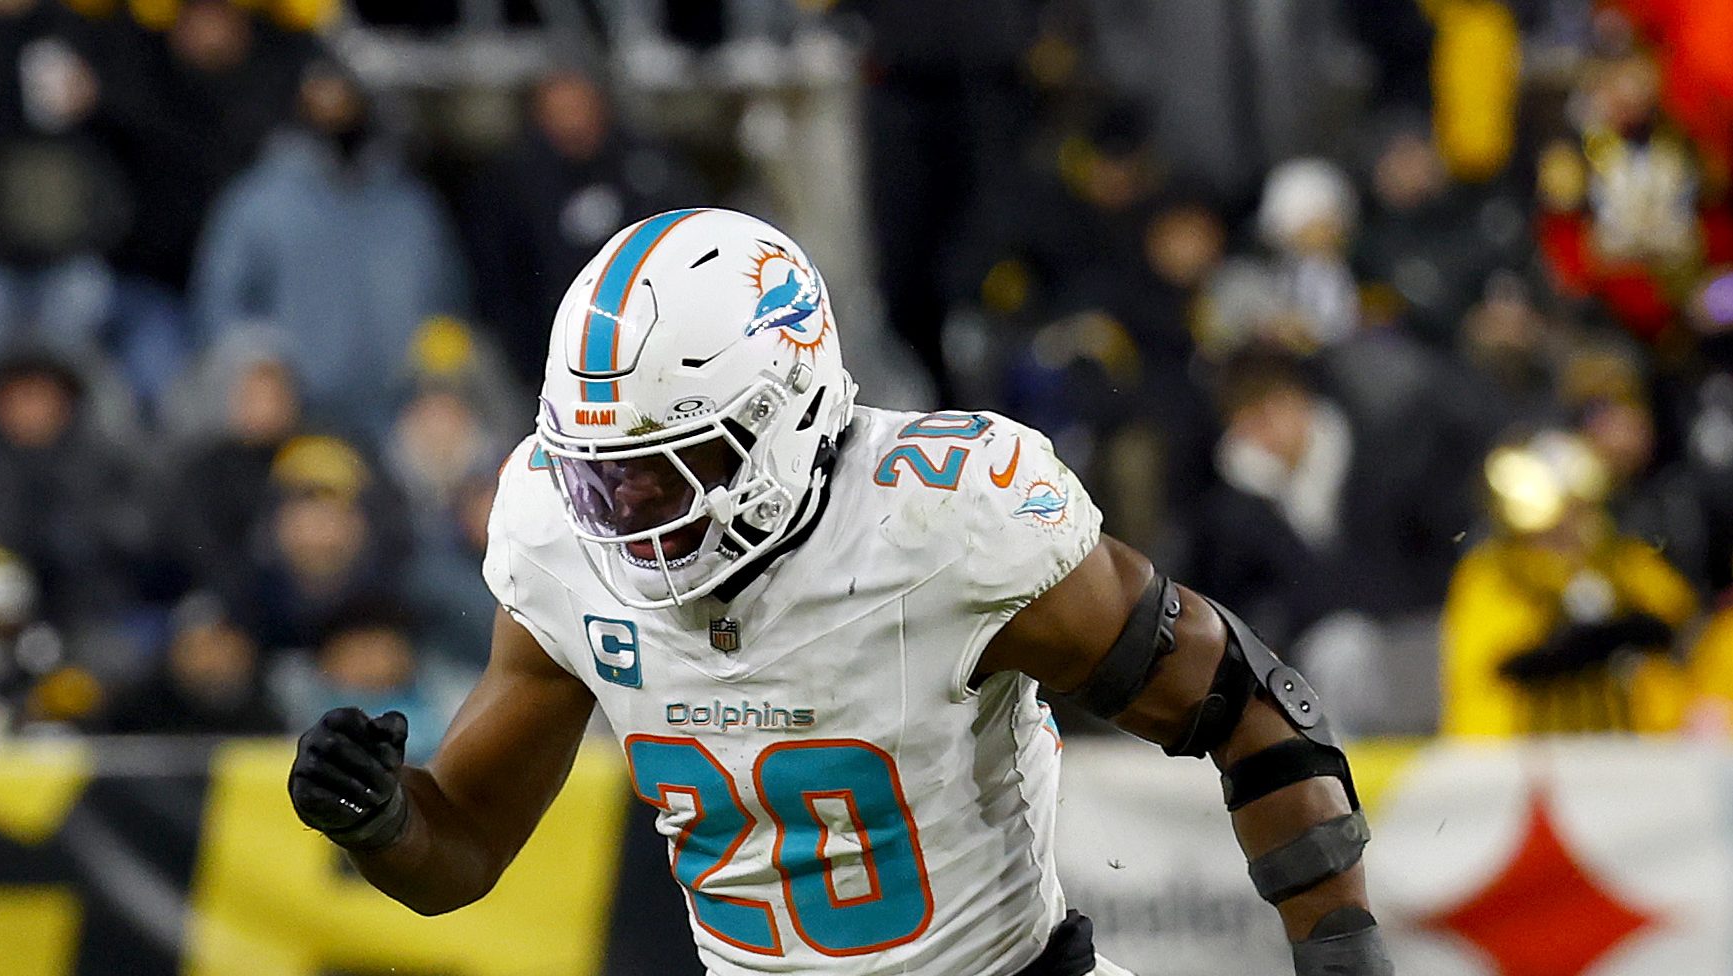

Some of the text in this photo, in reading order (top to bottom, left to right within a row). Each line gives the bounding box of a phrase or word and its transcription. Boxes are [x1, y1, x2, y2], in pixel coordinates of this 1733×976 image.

[575, 409, 616, 425] MIAMI
[873, 414, 994, 491] 20
[587, 620, 637, 670] C
[667, 699, 816, 732] Dolphins
[625, 733, 934, 957] 20
